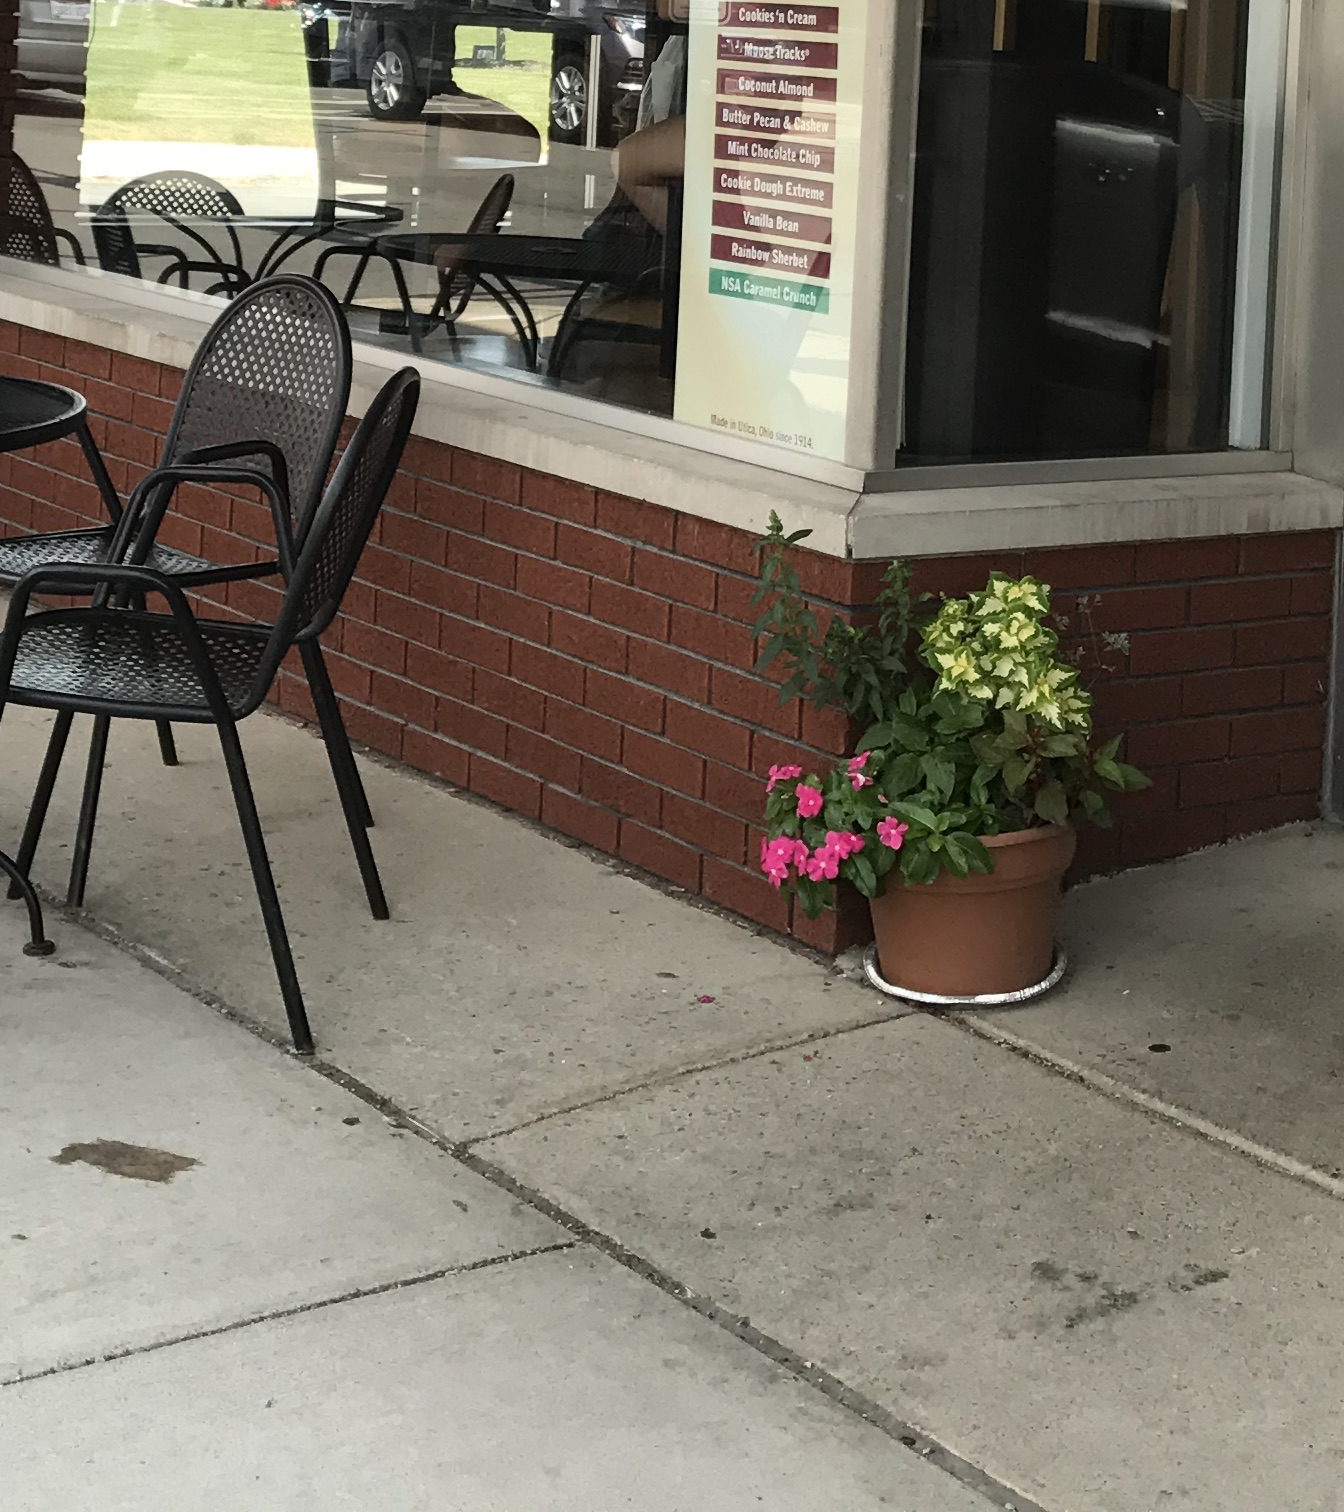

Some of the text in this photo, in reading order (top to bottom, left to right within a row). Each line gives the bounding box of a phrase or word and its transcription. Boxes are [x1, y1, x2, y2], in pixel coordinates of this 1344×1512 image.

[739, 8, 774, 23] Cookies
[788, 10, 816, 25] Cream
[744, 42, 775, 59] Moose
[739, 76, 813, 96] Coconut Almond
[722, 109, 829, 132] Butter Pecan & Cashew
[728, 141, 820, 168] Mint Chocolate Chip
[721, 174, 824, 201] Cookie Dough Extreme
[743, 211, 798, 232] Vanilla Bean
[732, 243, 808, 268] Rainbow Sherbet
[721, 276, 816, 306] NSA Caramel Crunch
[711, 414, 728, 428] Made
[759, 426, 773, 439] Ohio
[776, 431, 792, 443] since
